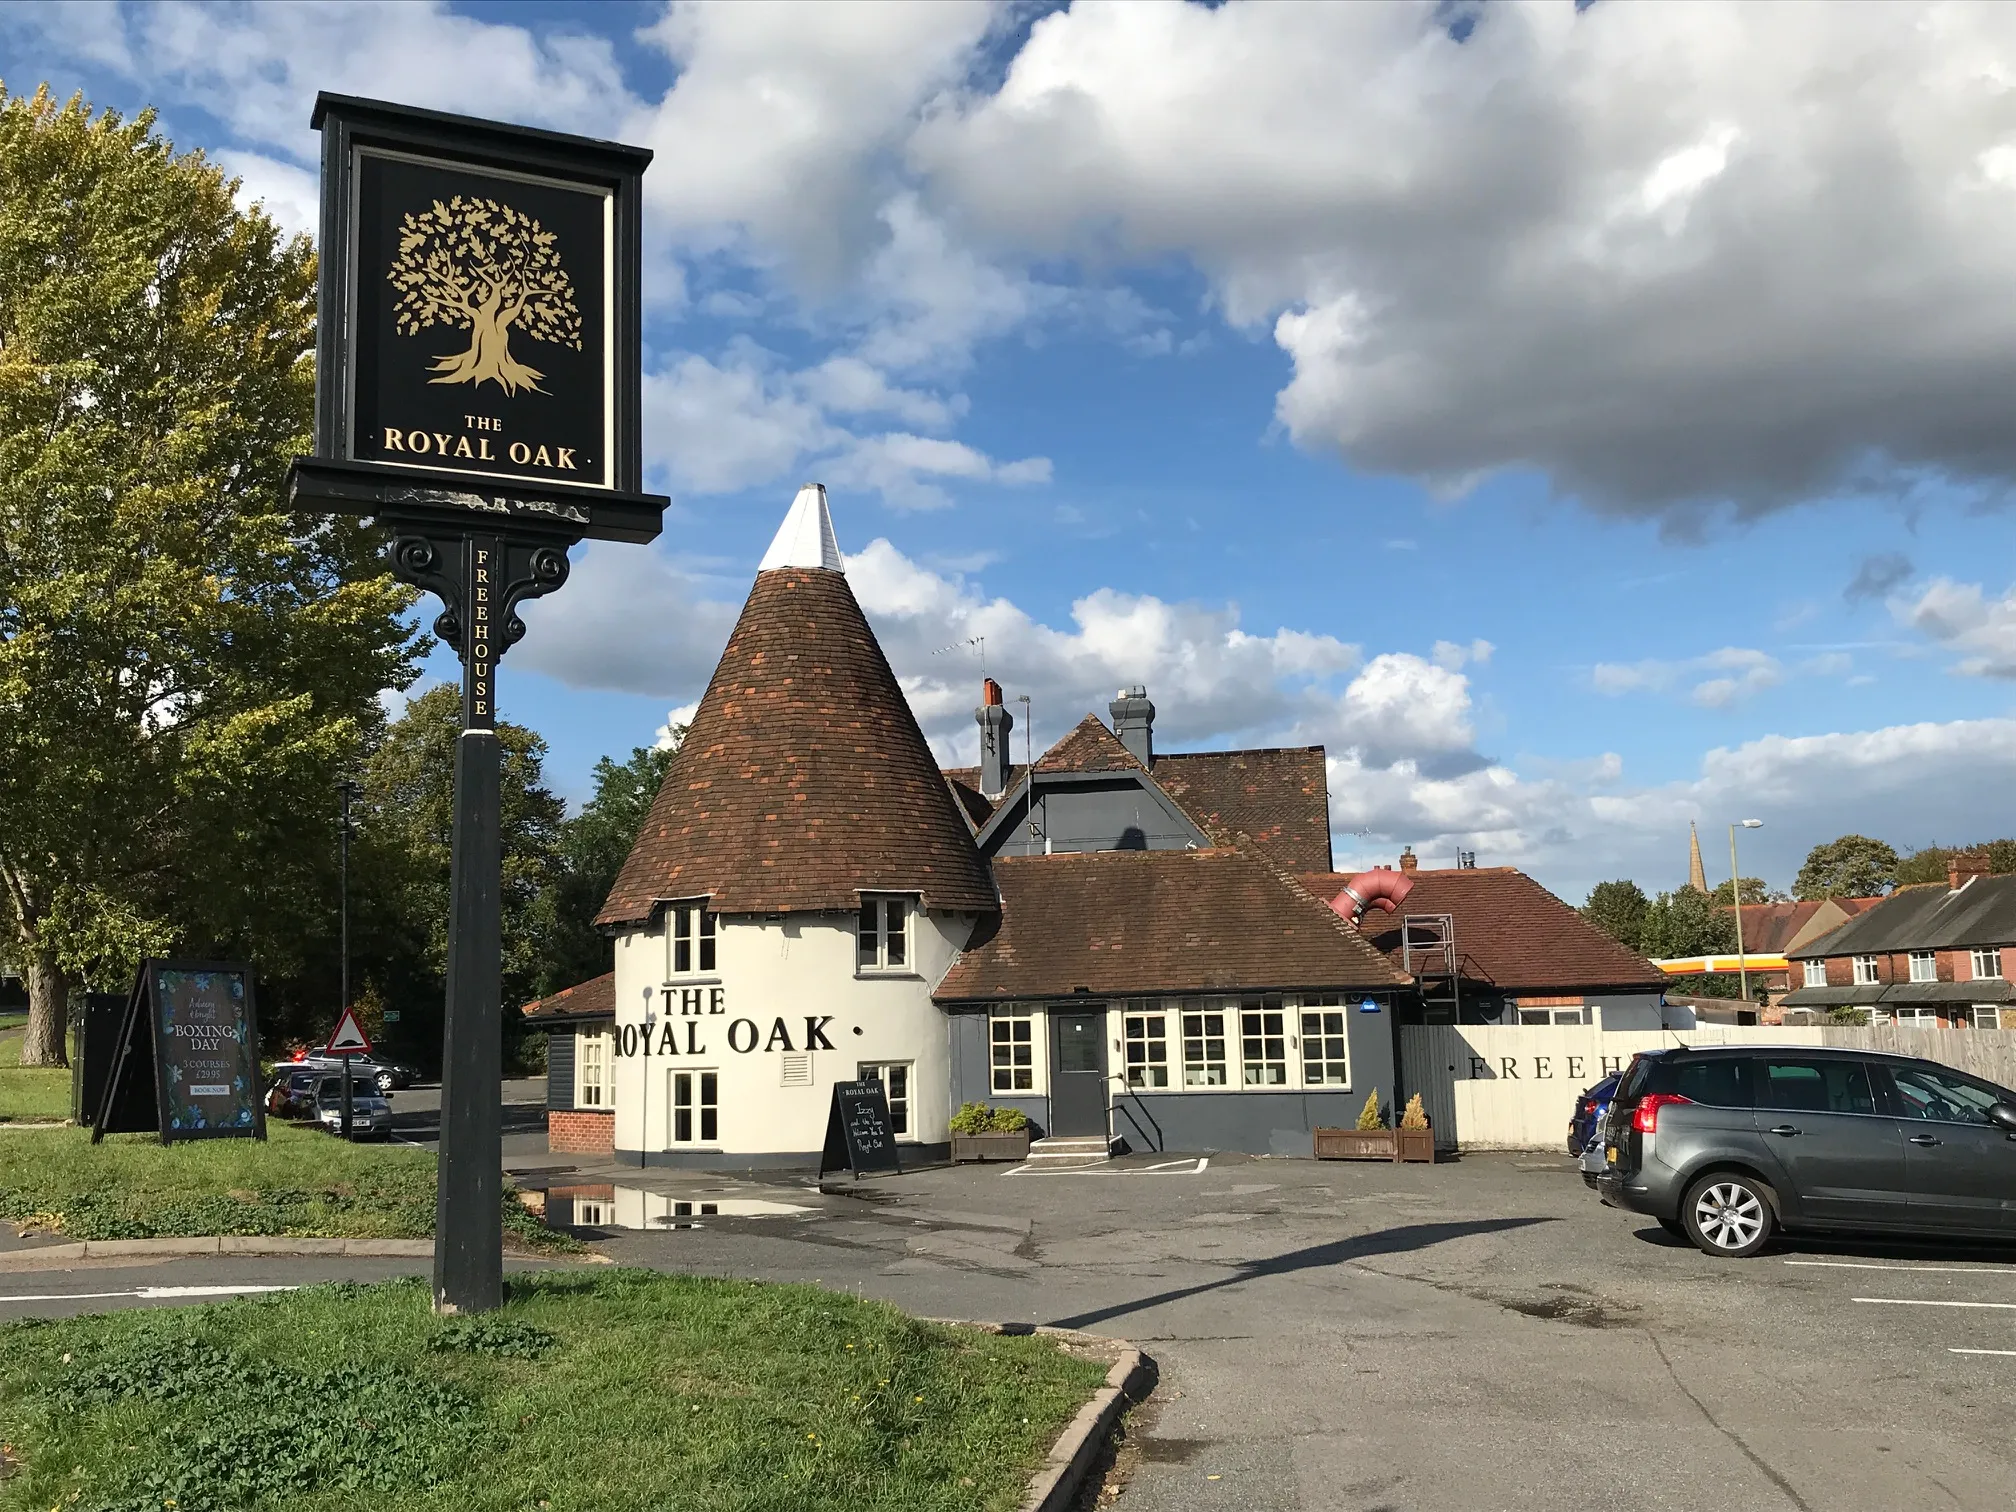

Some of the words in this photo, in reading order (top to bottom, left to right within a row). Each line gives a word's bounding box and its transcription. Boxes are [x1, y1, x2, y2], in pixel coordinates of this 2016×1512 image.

[465, 414, 502, 432] THE
[384, 427, 496, 461] ROYAL
[509, 442, 578, 471] OAK
[474, 550, 489, 715] FREEHOUSE
[660, 988, 726, 1016] THE
[174, 1024, 233, 1038] BOXING
[727, 1015, 838, 1054] OAK
[191, 1038, 220, 1051] DAY
[183, 1060, 189, 1068] 3
[189, 1060, 231, 1069] COURSES
[866, 1087, 879, 1095] OAK
